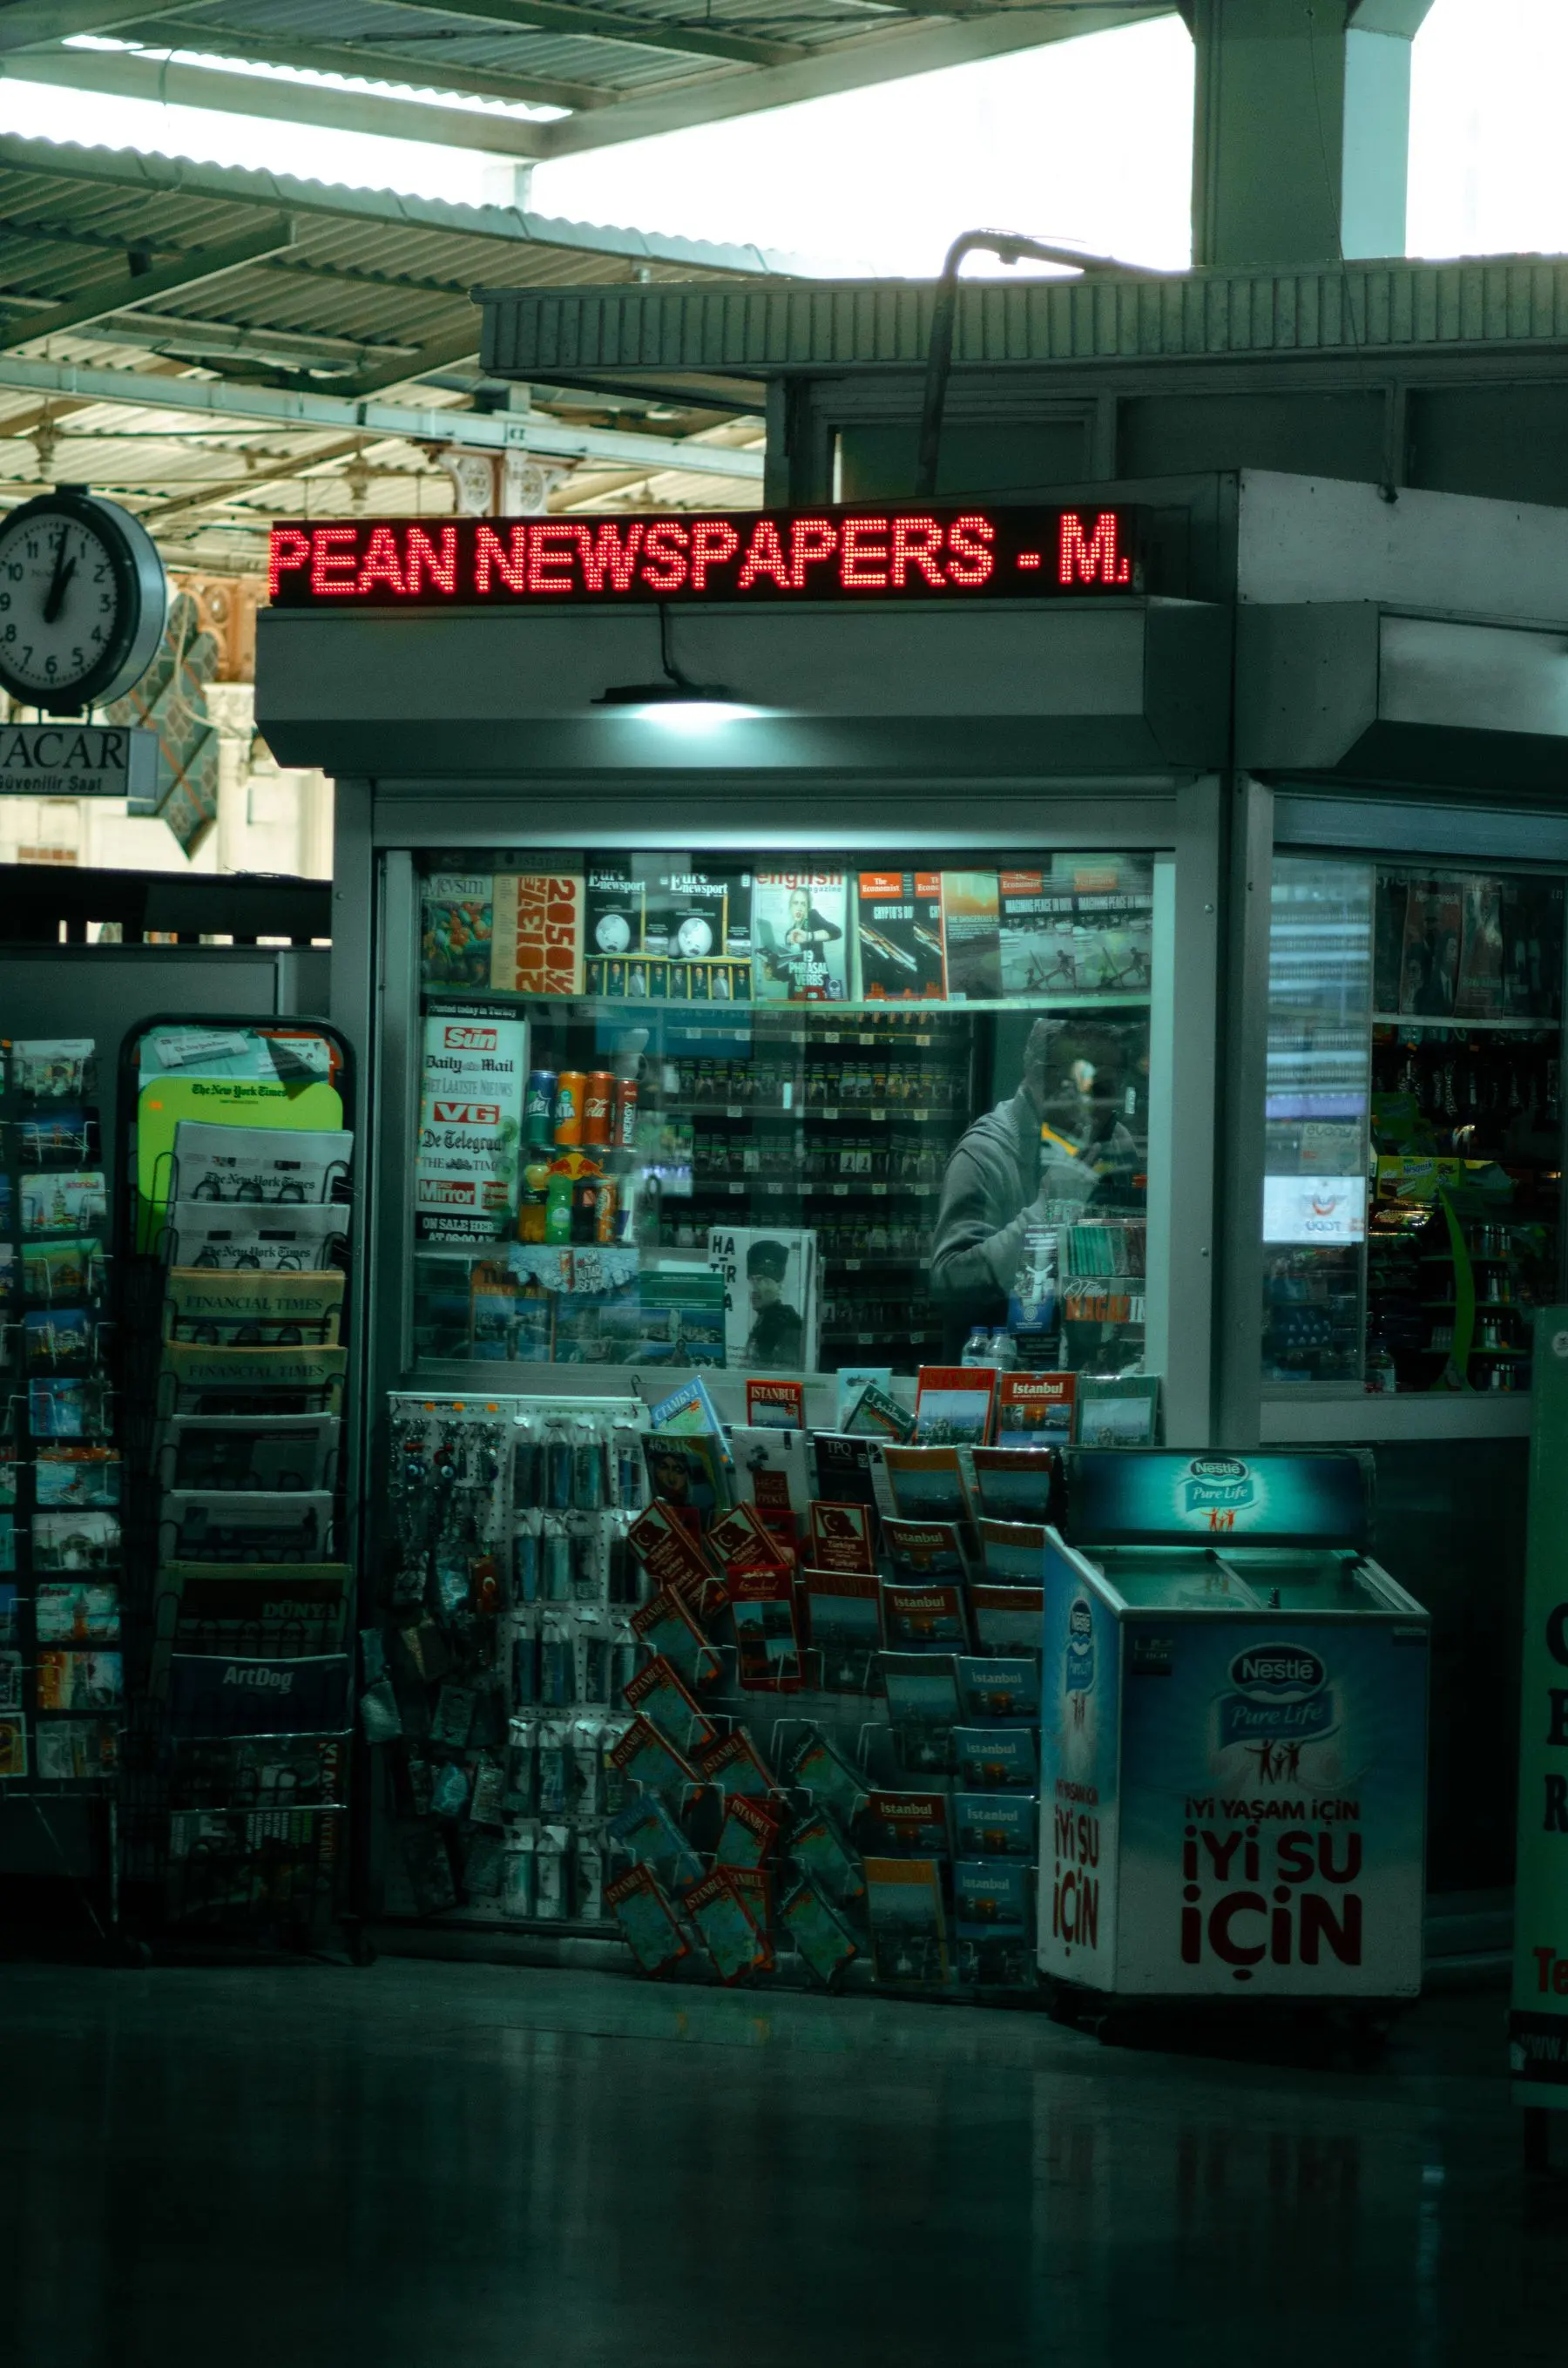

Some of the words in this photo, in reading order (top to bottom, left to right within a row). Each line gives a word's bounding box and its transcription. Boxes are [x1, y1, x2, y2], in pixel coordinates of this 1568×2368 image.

[26, 541, 38, 558] 11
[269, 526, 457, 594] PEAN
[476, 518, 995, 592] NEWSPAPERS
[8, 563, 23, 581] 10
[94, 565, 105, 583] 2
[0, 592, 10, 610] 9
[100, 593, 112, 612] 3
[5, 624, 17, 642] 8
[91, 625, 102, 642] 4
[23, 646, 33, 665] 7
[72, 647, 84, 666] 5
[45, 656, 57, 674] 6
[0, 731, 125, 768] ACAR
[69, 776, 103, 791] Saat
[446, 1028, 495, 1049] Sun
[426, 1055, 462, 1073] Daily
[481, 1059, 514, 1072] Mail
[192, 1084, 212, 1095] The
[212, 1085, 232, 1095] New
[233, 1086, 256, 1098] York
[258, 1086, 287, 1097] Times
[436, 1104, 497, 1124] VG
[622, 1101, 636, 1144] ENERGY
[422, 1129, 441, 1147] De
[444, 1129, 503, 1154] Telegraa
[419, 1181, 475, 1205] Mirror
[422, 1217, 437, 1230] ON
[439, 1218, 468, 1231] SALE
[470, 1220, 502, 1234] HER
[713, 1235, 735, 1255] HA
[186, 1296, 272, 1309] FINANCIAL
[275, 1298, 324, 1310] TIMES
[189, 1364, 271, 1377] FINANCIAL
[280, 1364, 325, 1377] TIMES
[752, 1386, 799, 1401] ISTANBUL
[1012, 1382, 1064, 1394] Istanbul
[1192, 1486, 1220, 1500] Pure
[1224, 1485, 1248, 1499] Life
[223, 1666, 296, 1695] ArtDog
[1230, 1705, 1282, 1728] Pure
[1284, 1702, 1325, 1726] Life
[1221, 1799, 1305, 1823] YAŞAM
[1078, 1815, 1098, 1868] SU
[1278, 1830, 1362, 1883] SU
